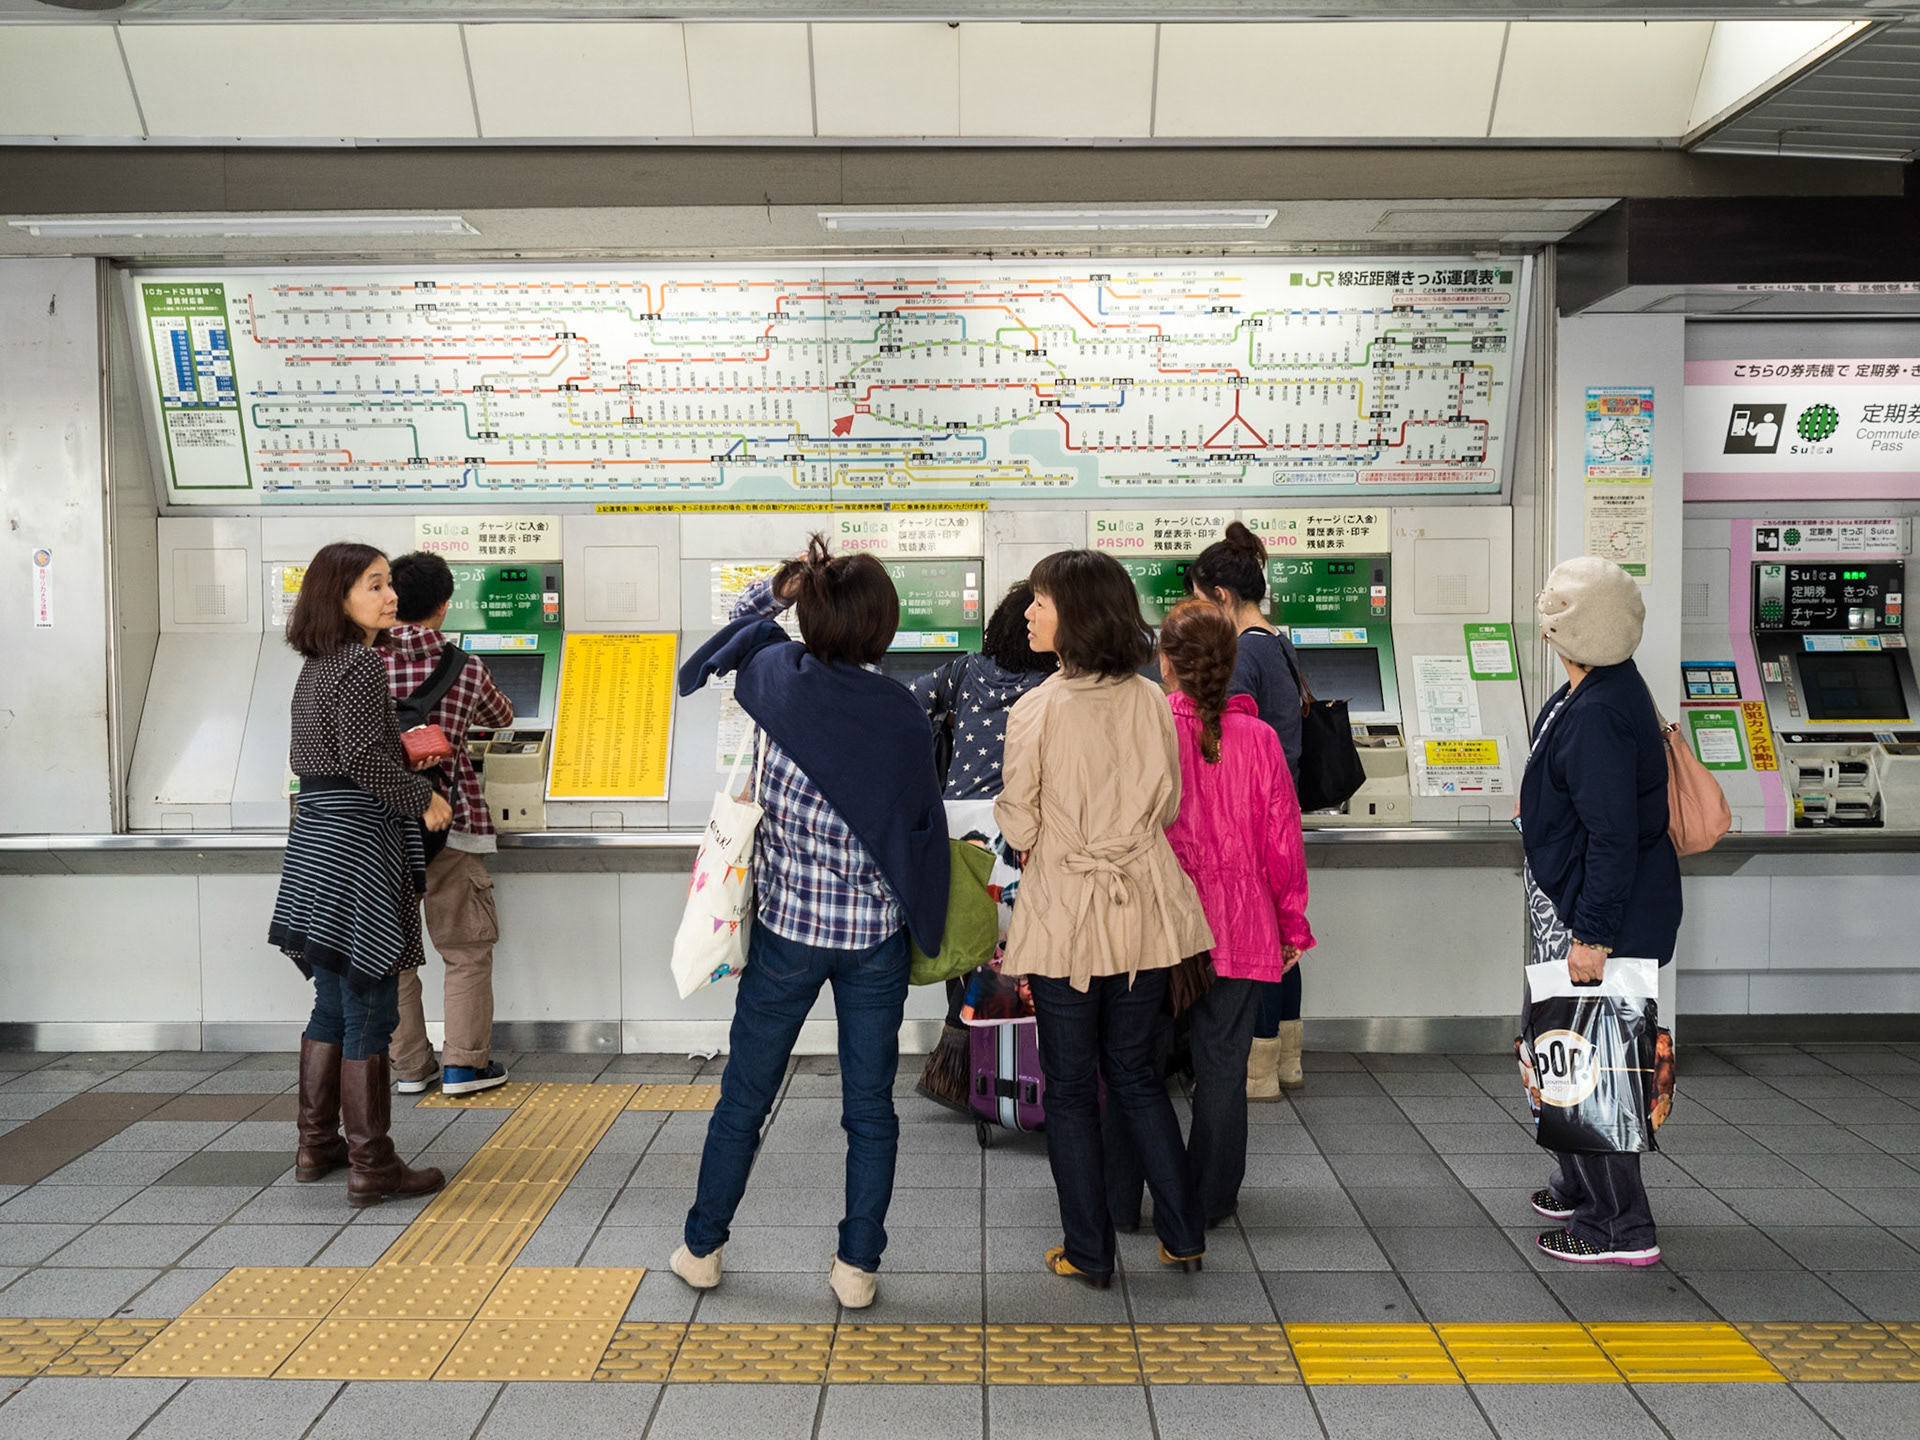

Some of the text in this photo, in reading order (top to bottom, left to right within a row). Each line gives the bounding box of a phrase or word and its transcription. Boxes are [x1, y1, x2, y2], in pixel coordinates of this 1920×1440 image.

[1305, 269, 1494, 287] JR 線近距離きっぷ運賃表
[1734, 364, 1850, 377] こちらの券売機で
[1856, 428, 1920, 440] Commute
[1790, 445, 1833, 454] Suica
[1871, 440, 1904, 451] Pass
[422, 523, 469, 535] Suica
[841, 521, 888, 533] Suica
[1097, 520, 1144, 531] Suica
[1250, 518, 1297, 530] Suica
[898, 530, 960, 539] 履歴表示・印字
[1154, 529, 1216, 538] 履歴表示・印字
[1307, 527, 1369, 537] 履歴表示・印字
[1809, 528, 1833, 536] 定期券
[1841, 528, 1863, 536] きっぷ
[1870, 527, 1895, 535] Suica
[479, 534, 541, 543] 履歴表示・印字
[1097, 538, 1144, 547] PASMO
[1260, 536, 1297, 546] ASMO
[422, 541, 469, 551] PASMO
[841, 539, 888, 549] PASMO
[898, 543, 936, 552] 残額表示
[1154, 541, 1192, 550] 残額表示
[1307, 539, 1345, 549] 残額表示
[479, 546, 516, 555] 残額表示
[1272, 561, 1313, 575] きっぷ
[1765, 566, 1780, 576] JR
[501, 571, 526, 579] 発売中
[1271, 576, 1288, 584] Ticket
[1790, 570, 1837, 580] Suica
[1792, 586, 1827, 597] 定期券
[1843, 585, 1878, 597] きっぷ
[1271, 593, 1314, 602] Suica
[1791, 607, 1838, 619] チャージ
[1743, 702, 1774, 770] 防犯カメラ作動中
